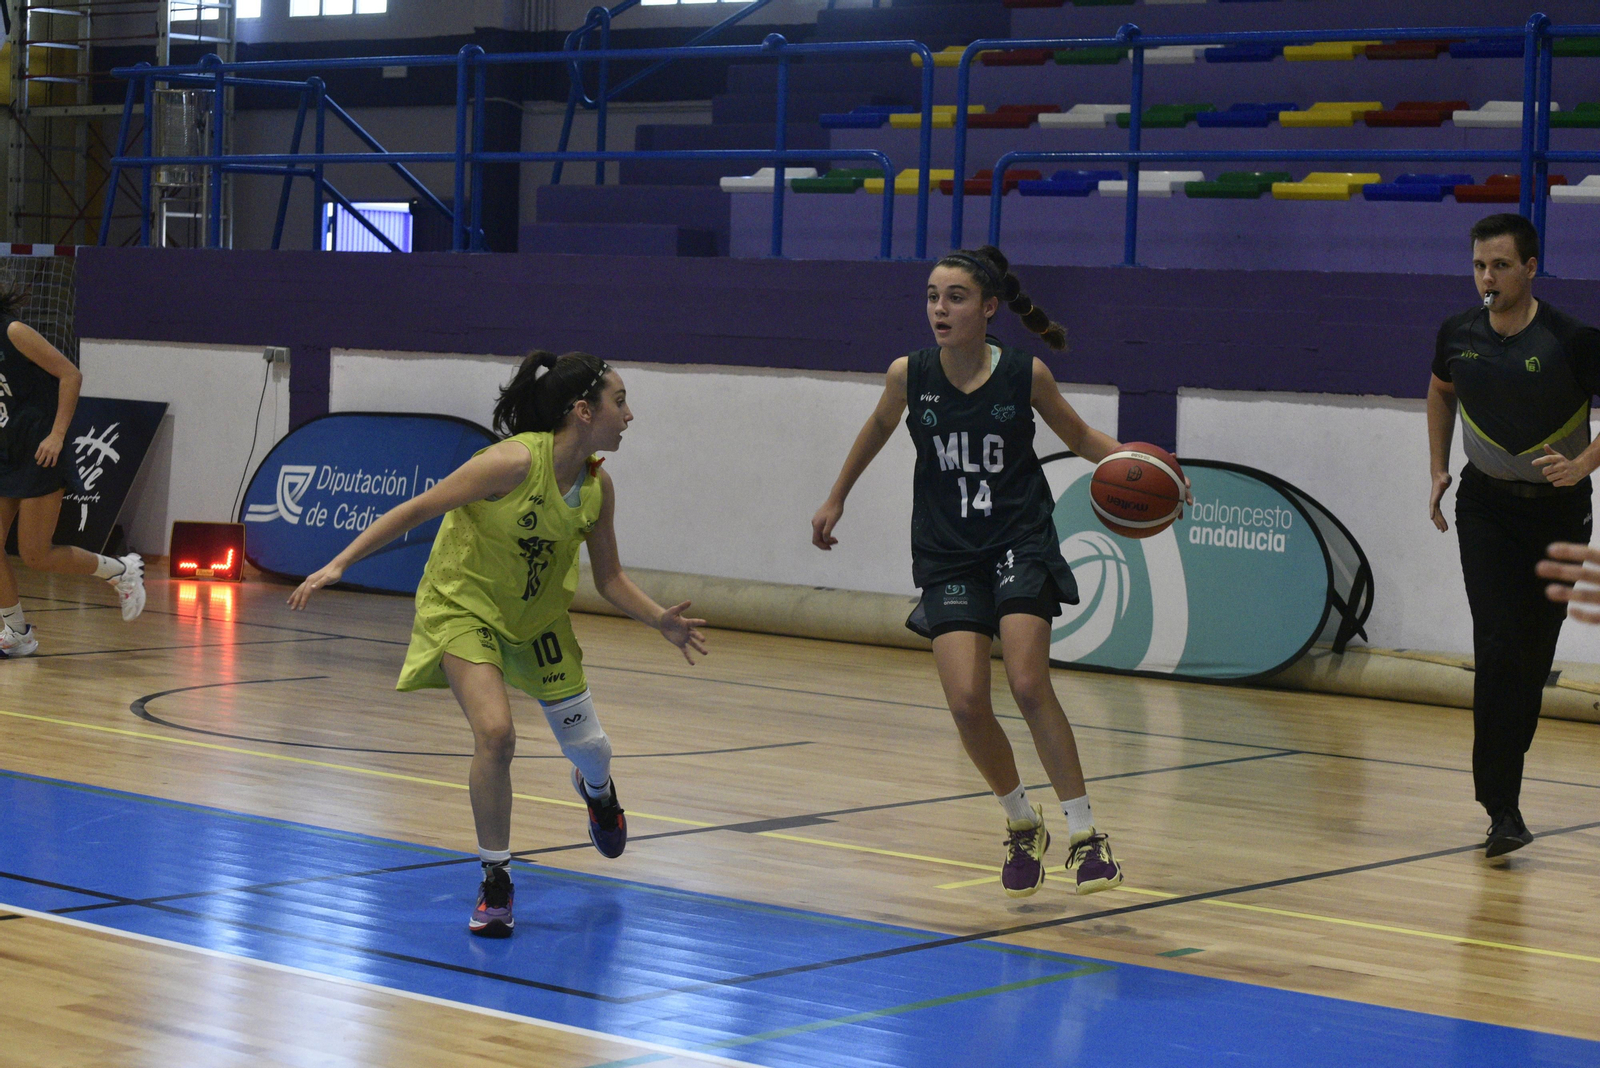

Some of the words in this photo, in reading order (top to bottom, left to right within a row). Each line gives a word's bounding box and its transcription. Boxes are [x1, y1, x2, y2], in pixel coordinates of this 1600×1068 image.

[932, 431, 1005, 473] MLG
[316, 465, 407, 497] Diputación
[957, 476, 993, 518] 14
[305, 501, 328, 527] de
[333, 502, 383, 532] Cádi
[1106, 494, 1149, 512] molten
[1191, 497, 1293, 529] baloncesto
[531, 631, 563, 668] 10
